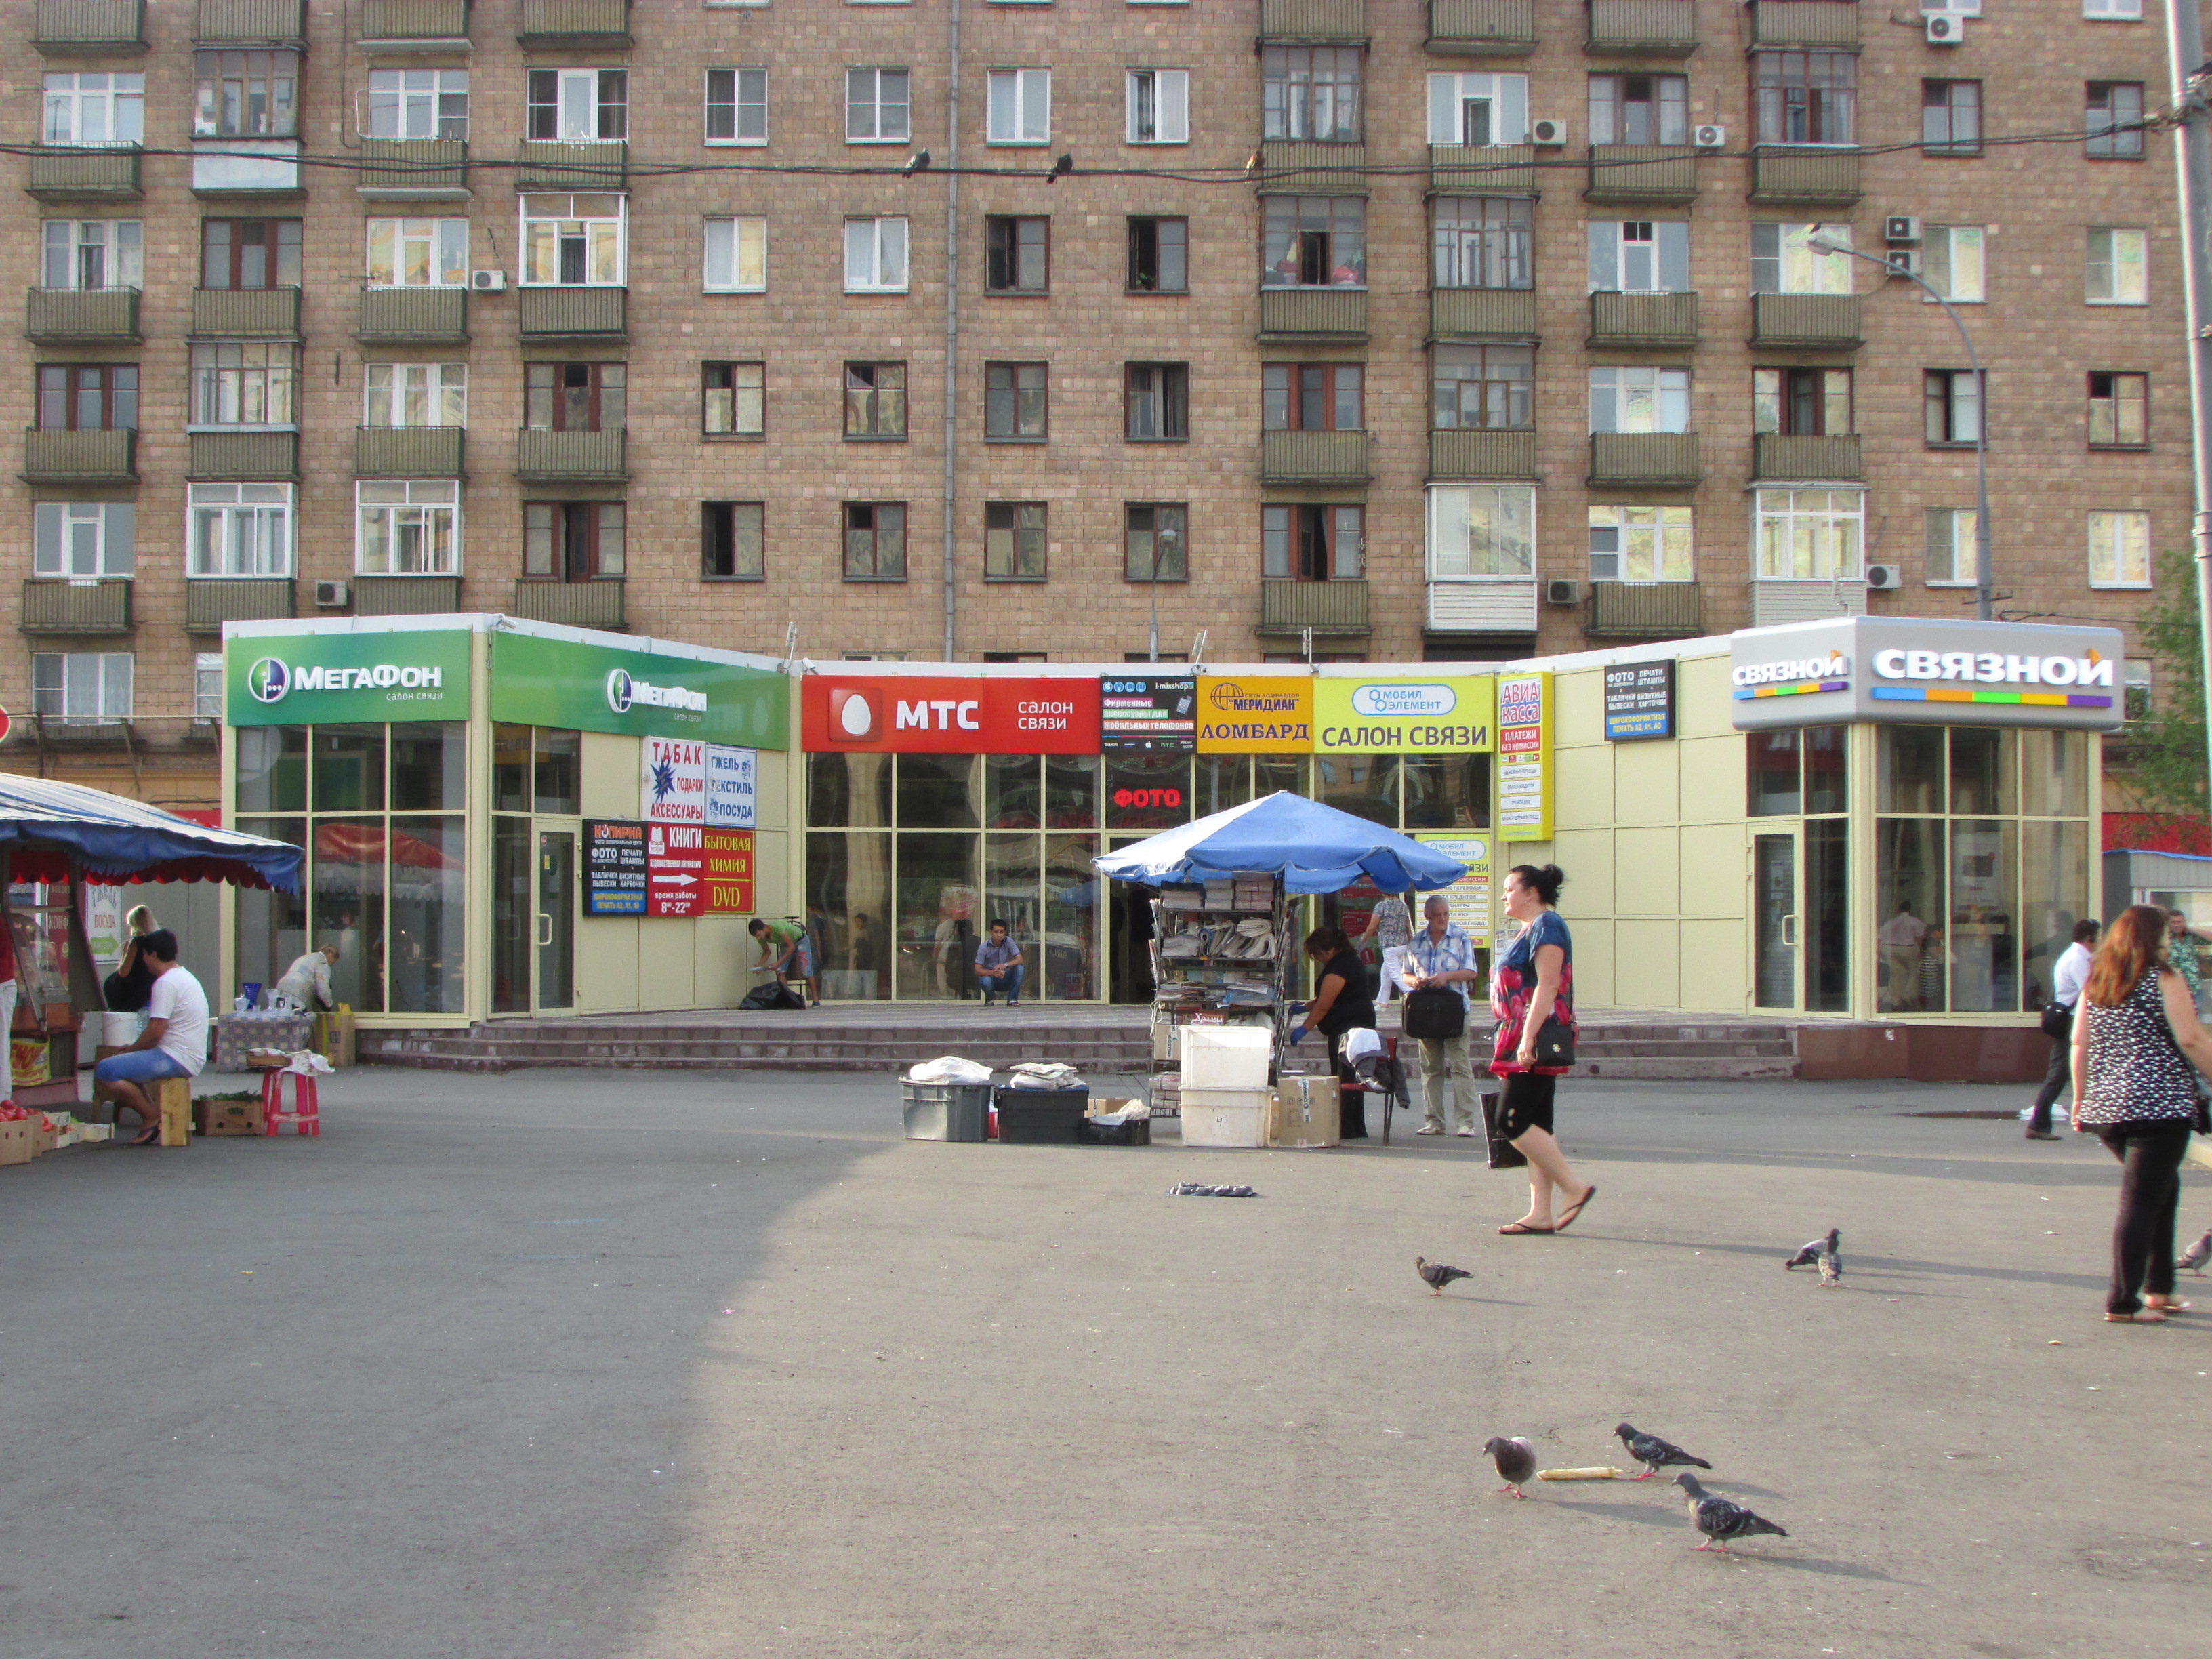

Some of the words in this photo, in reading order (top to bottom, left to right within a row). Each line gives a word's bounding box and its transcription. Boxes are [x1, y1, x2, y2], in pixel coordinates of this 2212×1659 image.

[1639, 668, 1663, 678] ПЕЧАТИ
[1732, 650, 1847, 686] СВЯЗНОЙ
[1872, 649, 2113, 686] СВЯЗНОЙ
[1607, 671, 1634, 683] ФОТО
[1638, 676, 1665, 685] ШТАМПЫ
[386, 693, 413, 701] салон
[417, 692, 443, 700] связи
[1383, 691, 1422, 699] МОБИЛ
[1502, 682, 1539, 704] АВИА
[1607, 693, 1635, 702] ТАБЛИЧКИ
[1637, 691, 1666, 700] ВИЗИТНЫЕ
[1018, 701, 1073, 714] салон
[1104, 699, 1152, 707] Фирменные
[1389, 701, 1441, 710] ЭЛЕМЕНТ
[1608, 701, 1634, 710] ВЫВЕСКИ
[1638, 699, 1666, 708] КАРТОЧКИ
[895, 701, 979, 730] МТС
[1018, 718, 1067, 730] связи
[1104, 721, 1149, 729] мобильных
[1151, 722, 1194, 730] телефонов
[1200, 724, 1309, 741] ЛОМБАРД
[1322, 727, 1401, 747] САЛОН
[1410, 726, 1486, 746] СВЯЗИ
[1505, 730, 1536, 741] ПЛАТЕЖИ
[653, 742, 701, 765] ТАБАК
[711, 756, 739, 771] ГЖЕЛЬ
[677, 777, 703, 793] ПОДАРКИ
[1114, 788, 1181, 807] ФОТО
[651, 803, 703, 819] АКСЕССУАРЫ
[720, 804, 752, 819] ПОСУДА
[670, 827, 702, 848] КНИГИ
[705, 836, 750, 851] БЫТОВАЯ
[592, 848, 617, 859] ФОТО
[709, 858, 745, 872] ХИМИЯ
[1468, 863, 1488, 872] ЯЗИ
[675, 891, 697, 899] работы
[714, 886, 741, 907] DVD
[1216, 1116, 1223, 1127] 4
